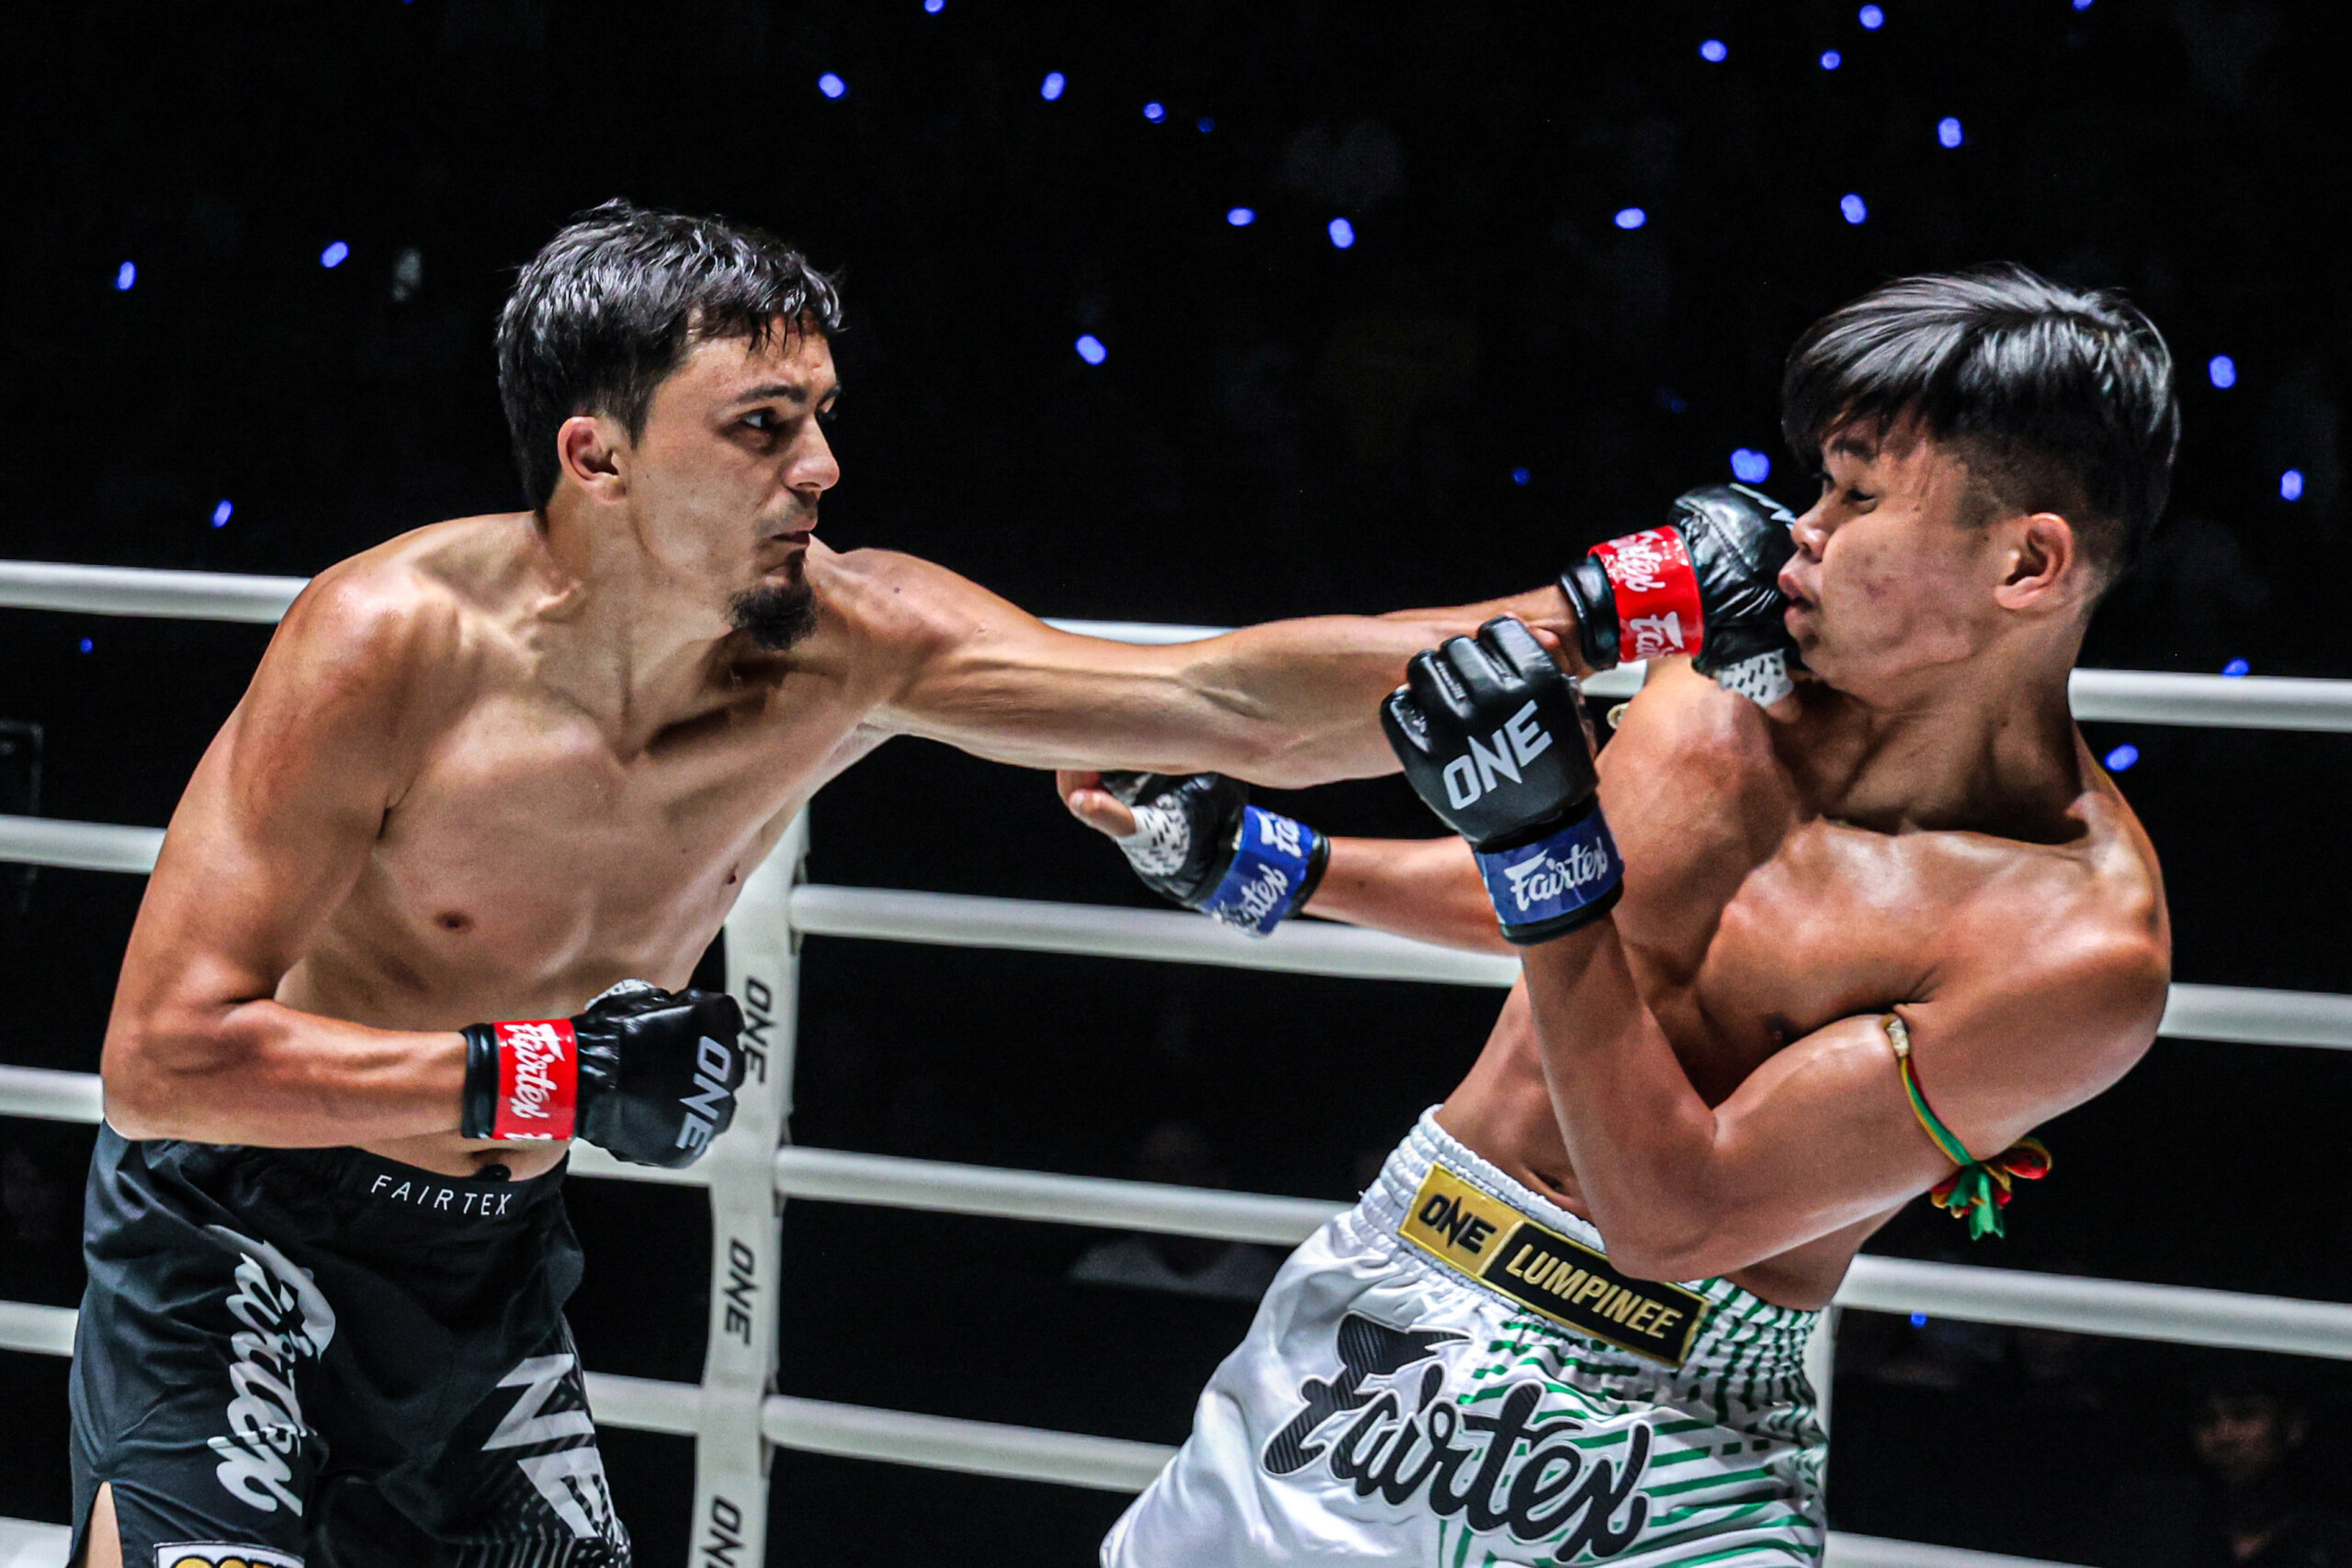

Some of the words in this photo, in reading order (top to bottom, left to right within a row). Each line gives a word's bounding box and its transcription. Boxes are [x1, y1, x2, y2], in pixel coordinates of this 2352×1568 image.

[1442, 699, 1555, 810] ONE
[1503, 836, 1609, 912] Fairtex
[503, 1022, 566, 1119] Fairtex
[744, 976, 775, 1084] ONE
[678, 1035, 732, 1157] ONE
[371, 1174, 513, 1216] FAIRTEX
[723, 1237, 759, 1347] ONE
[1418, 1194, 1498, 1255] ONE
[1504, 1242, 1684, 1341] LUMPINEE
[1262, 1312, 1653, 1562] Fairtex
[701, 1495, 742, 1568] ON
